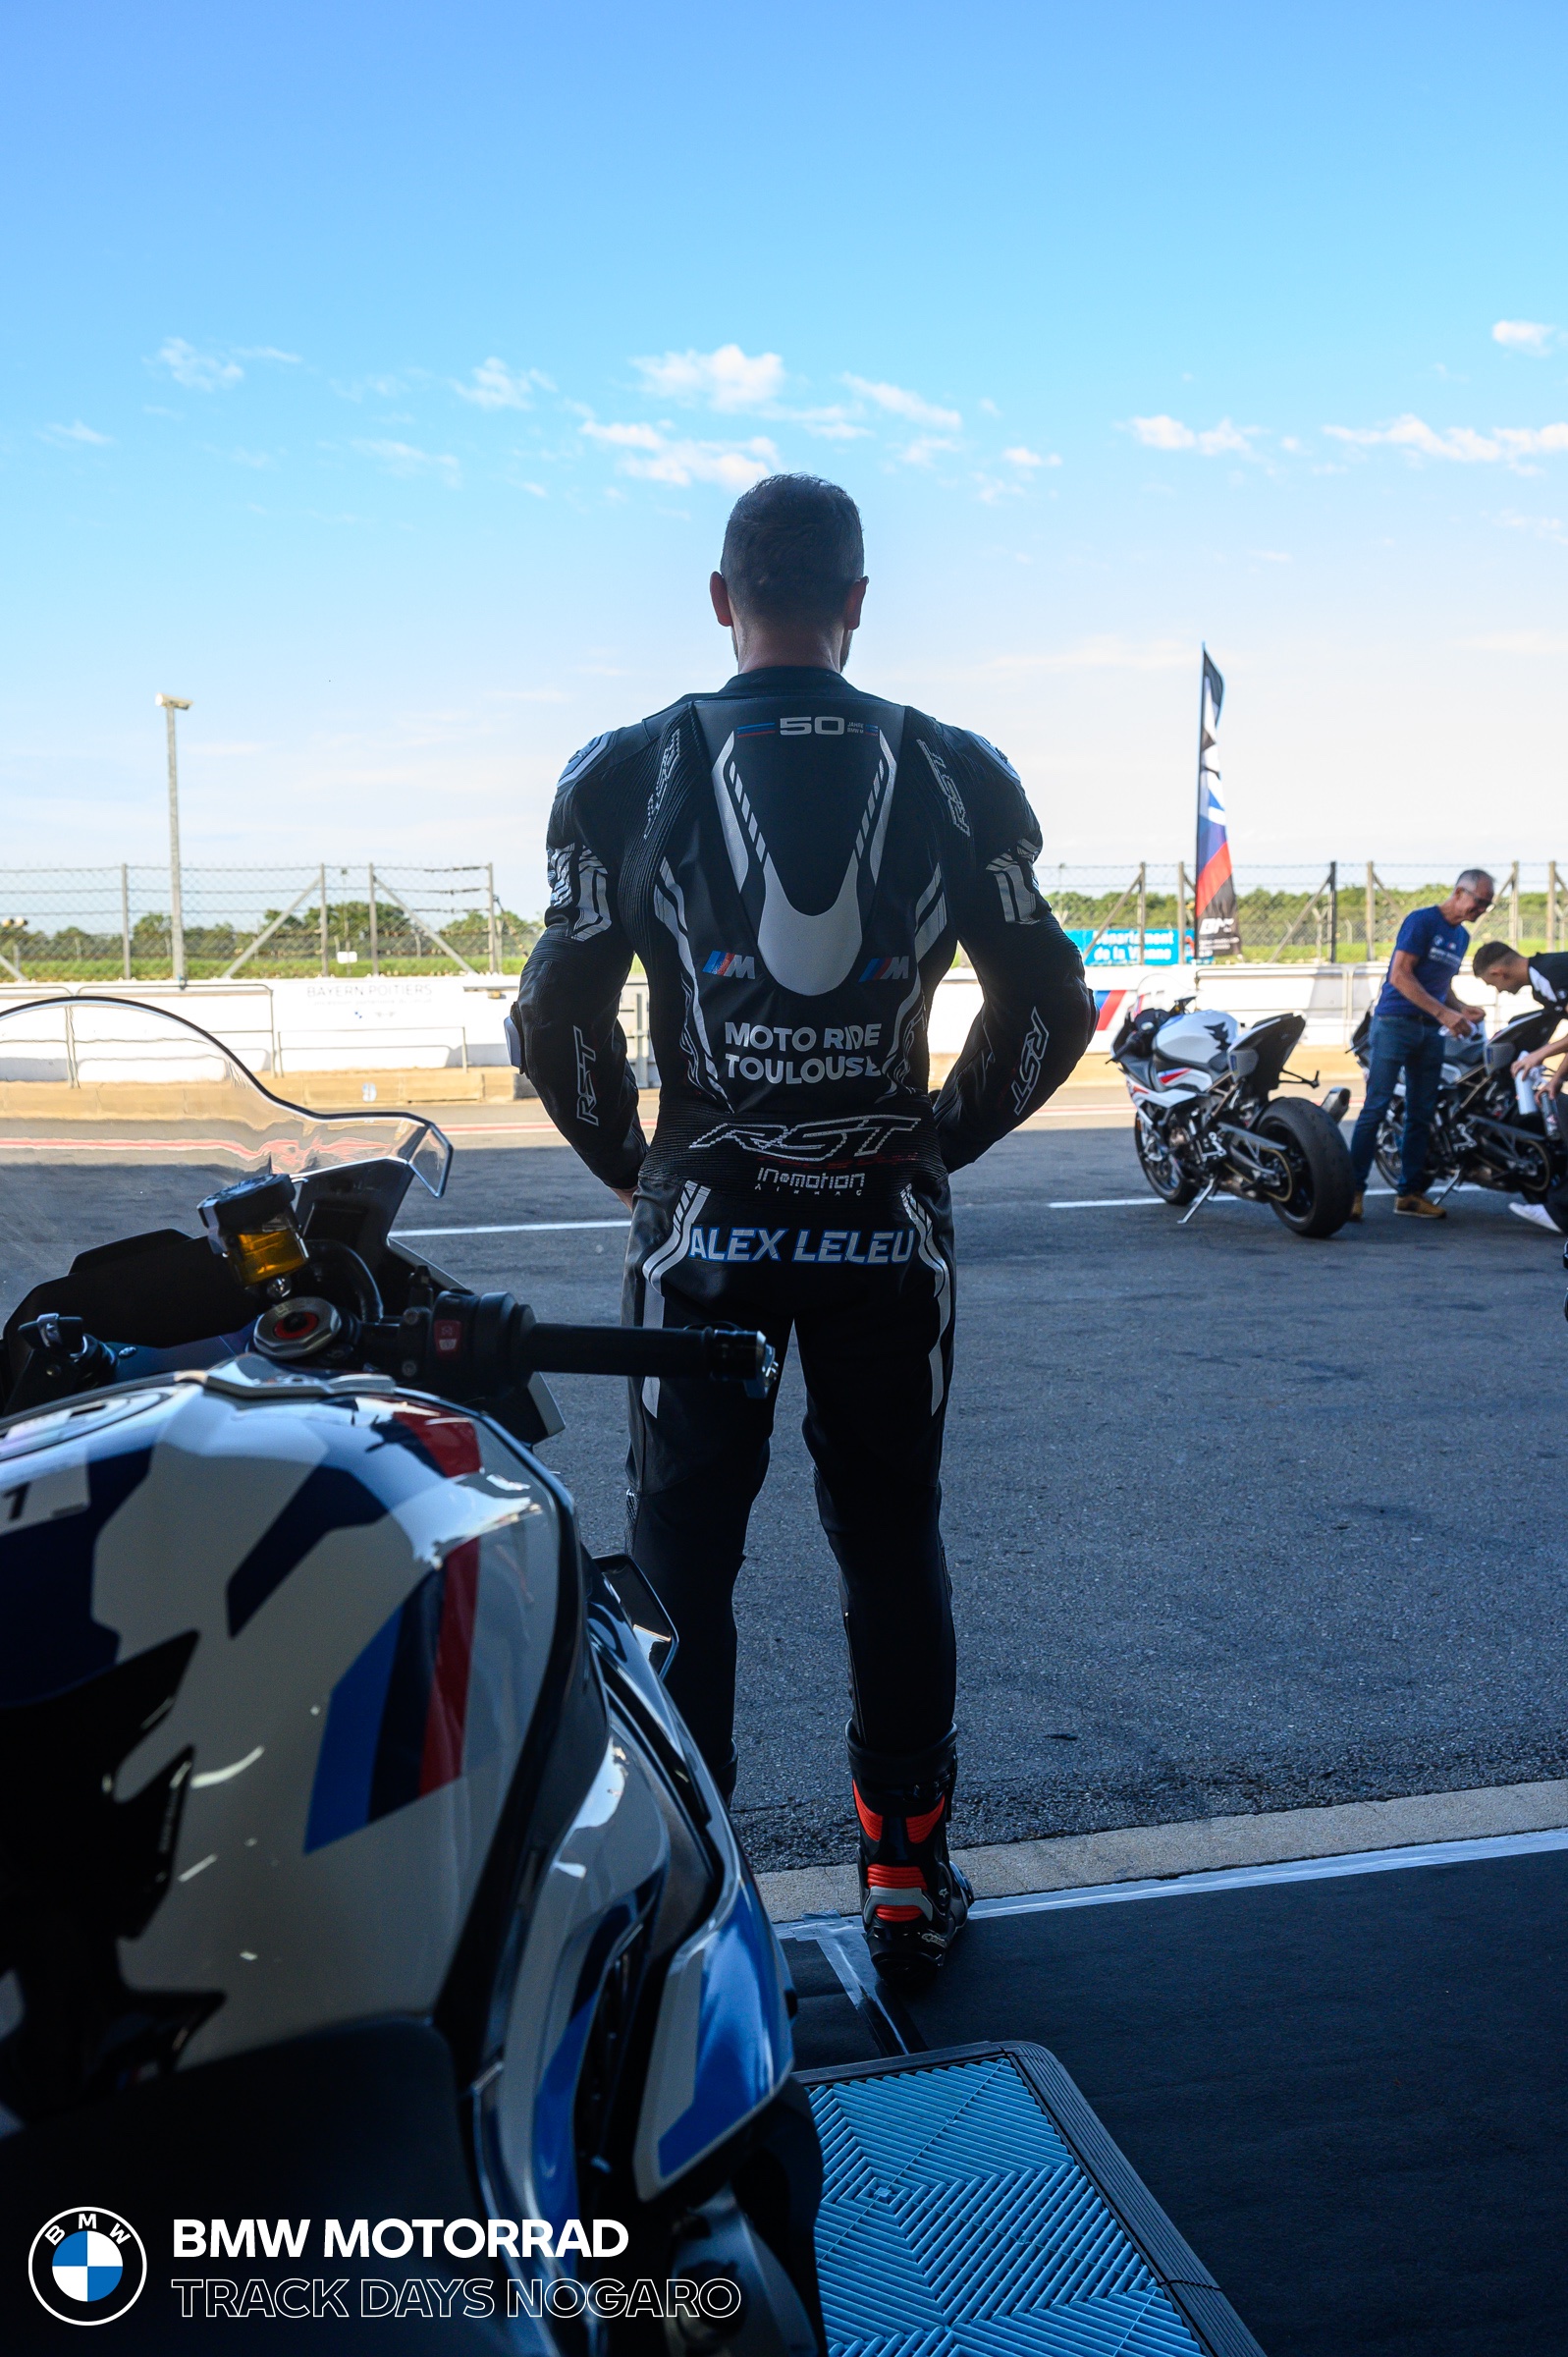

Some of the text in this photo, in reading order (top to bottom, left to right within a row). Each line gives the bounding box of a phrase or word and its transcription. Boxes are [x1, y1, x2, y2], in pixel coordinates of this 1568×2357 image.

[780, 716, 845, 736] 50
[306, 983, 432, 998] BAYERN POITIERS
[725, 1021, 883, 1052] MOTO RIDE
[573, 1025, 599, 1126] RST
[725, 1053, 883, 1085] TOULOUSE
[1011, 1006, 1050, 1117] RST
[688, 1114, 922, 1162] RST
[689, 1228, 915, 1264] ALEX LELEU
